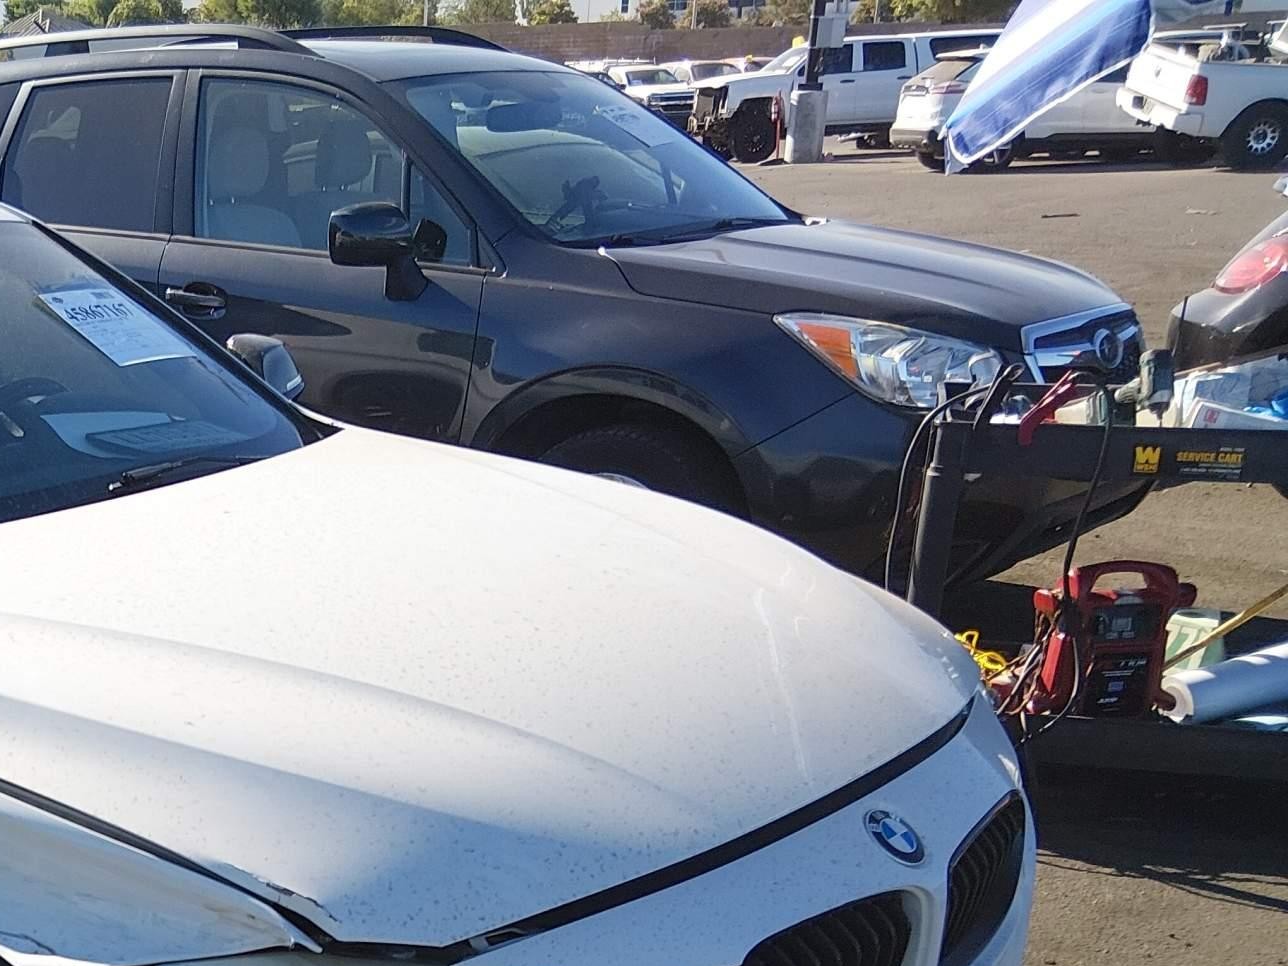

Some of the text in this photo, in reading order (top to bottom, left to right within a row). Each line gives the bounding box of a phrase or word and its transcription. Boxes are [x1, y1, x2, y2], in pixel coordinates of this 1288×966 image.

[64, 303, 134, 321] 45867167
[1176, 450, 1243, 464] SERVICE CART
